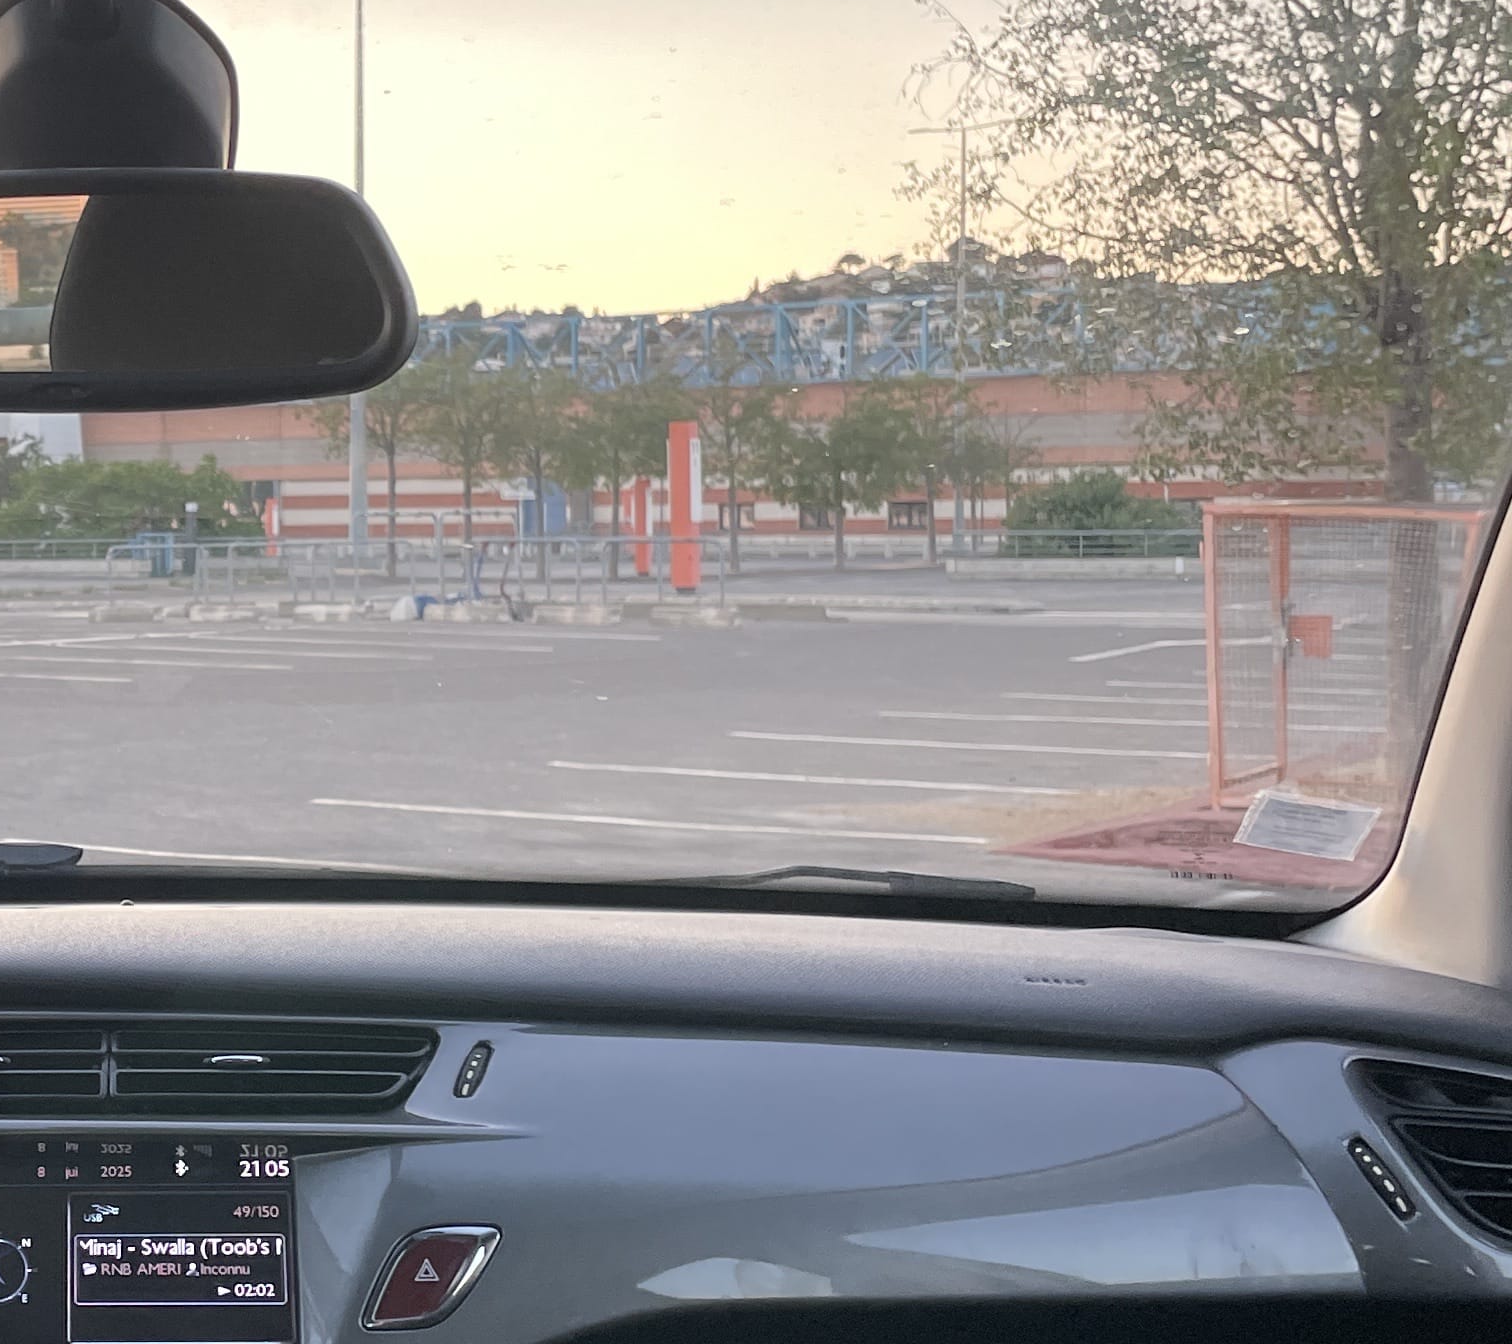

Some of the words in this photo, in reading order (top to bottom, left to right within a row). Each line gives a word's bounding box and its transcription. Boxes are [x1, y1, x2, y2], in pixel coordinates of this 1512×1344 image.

[37, 1166, 46, 1177] 8
[100, 1166, 132, 1178] 2025
[232, 1205, 279, 1218] 49/150
[83, 1213, 103, 1223] USB
[21, 1238, 32, 1248] N
[140, 1239, 194, 1256] Swalla
[199, 1238, 270, 1260] (Toob's
[100, 1263, 131, 1275] RNB
[136, 1263, 181, 1275] AMERI
[200, 1263, 250, 1275] Inconnu
[233, 1284, 275, 1297] 02:02
[21, 1293, 29, 1304] E
